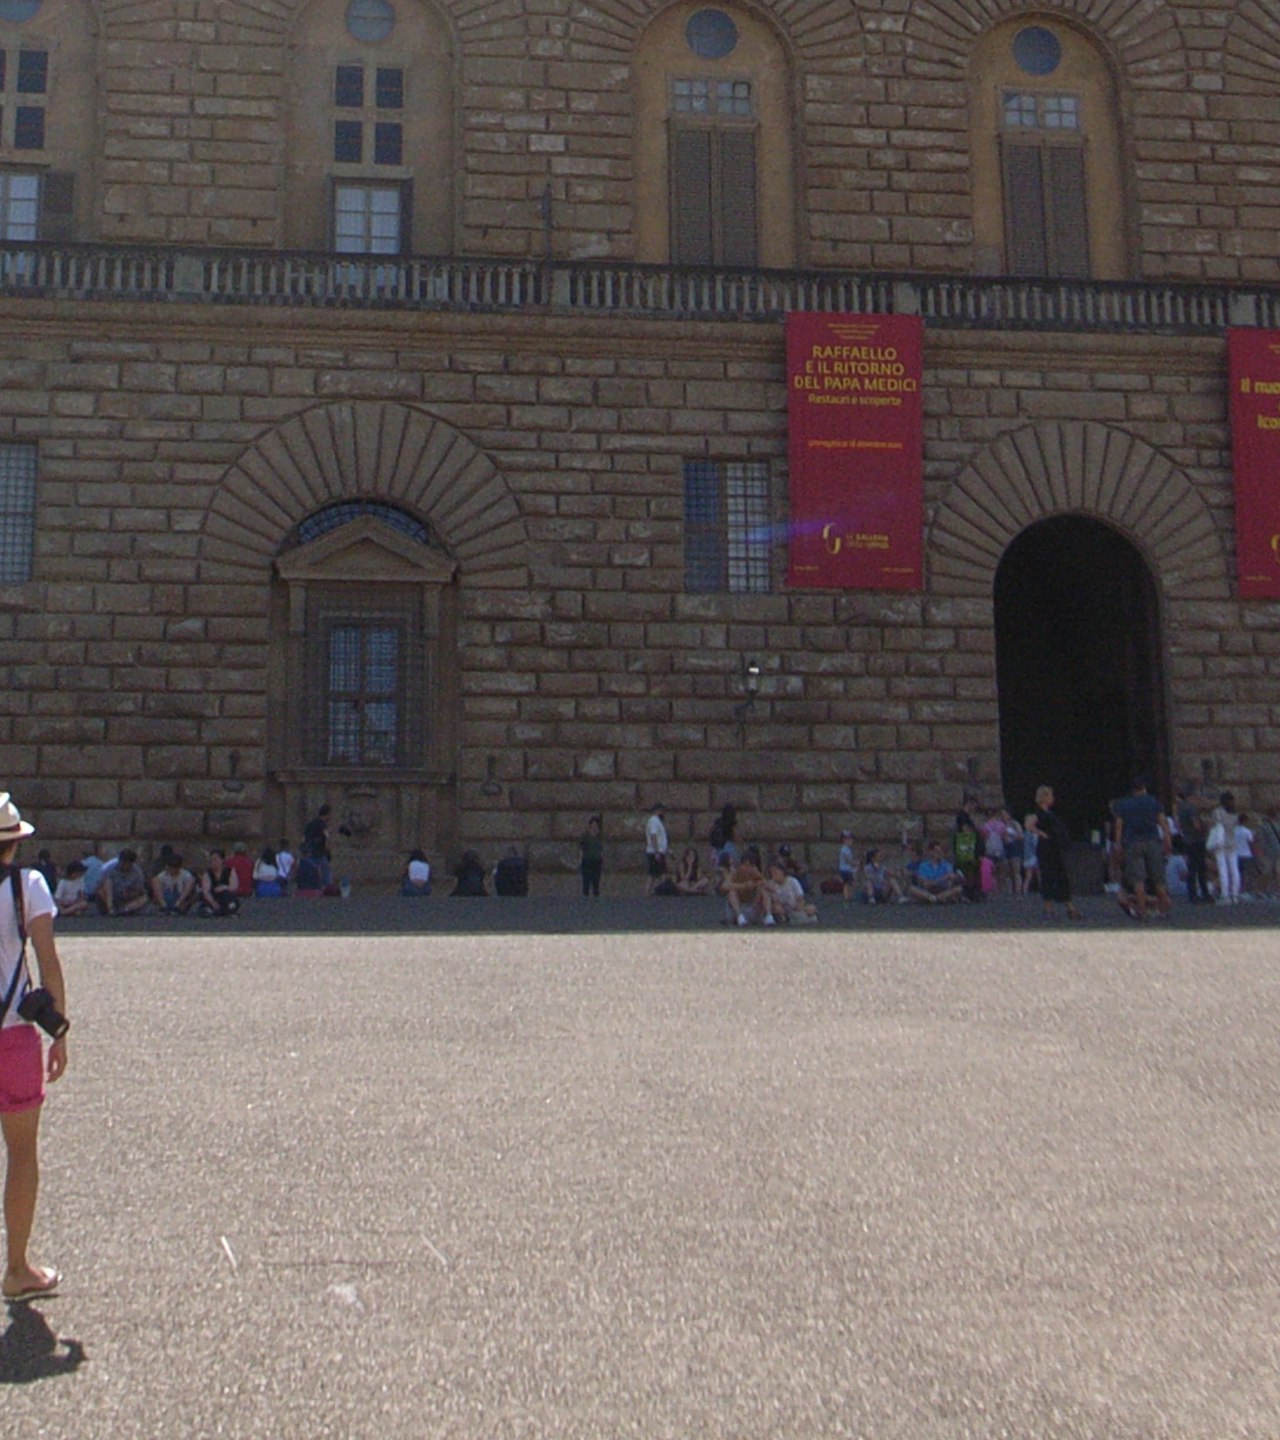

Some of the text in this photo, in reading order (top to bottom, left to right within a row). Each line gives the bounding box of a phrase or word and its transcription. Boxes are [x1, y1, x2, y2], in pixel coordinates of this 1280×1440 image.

[812, 345, 897, 361] RAFFAELLO
[805, 360, 905, 376] E IL RITORNO
[794, 375, 917, 392] DEL PAPA MEDICI
[808, 393, 902, 407] Restauri e scoperte
